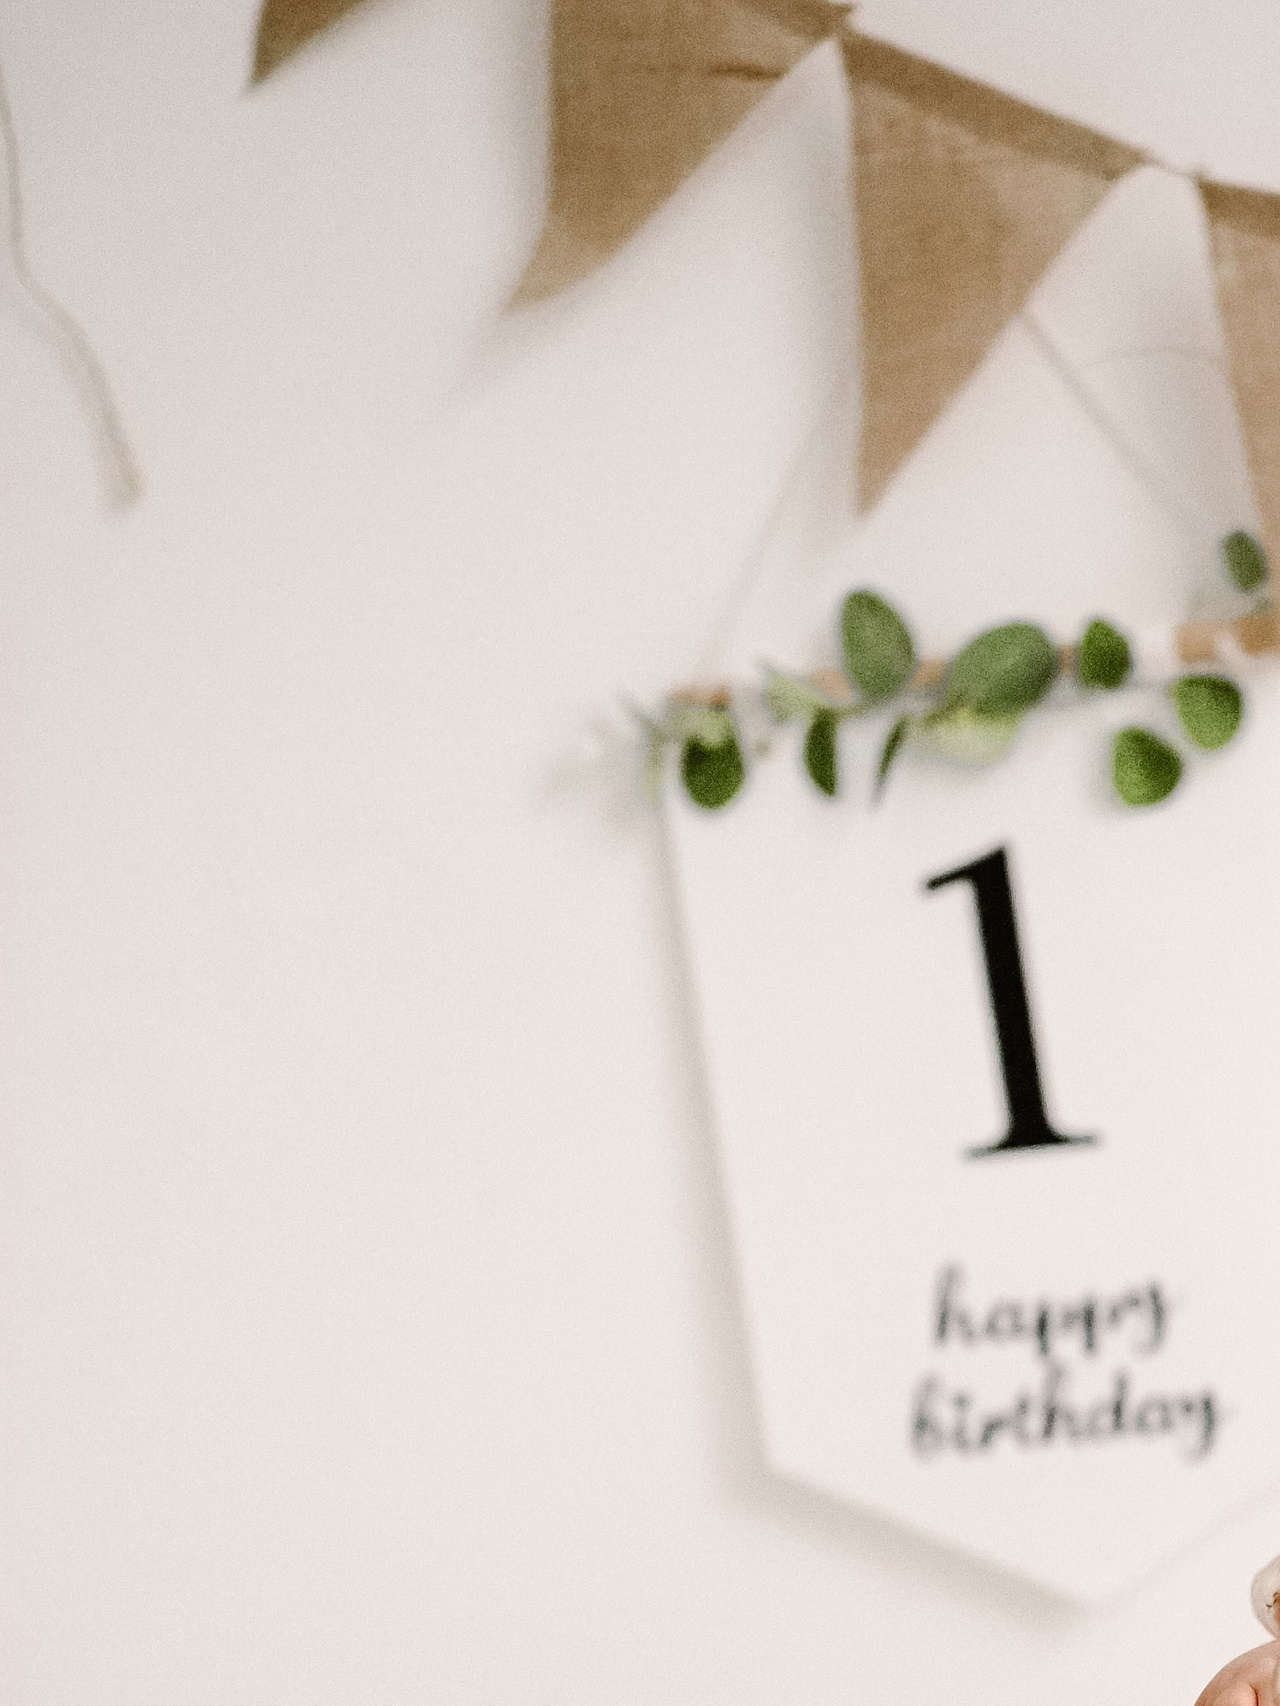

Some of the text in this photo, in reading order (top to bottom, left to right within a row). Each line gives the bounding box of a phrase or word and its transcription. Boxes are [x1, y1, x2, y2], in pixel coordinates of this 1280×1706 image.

[922, 842, 1100, 1160] 1
[934, 1261, 1169, 1358] happy
[909, 1357, 1222, 1463] birthday
